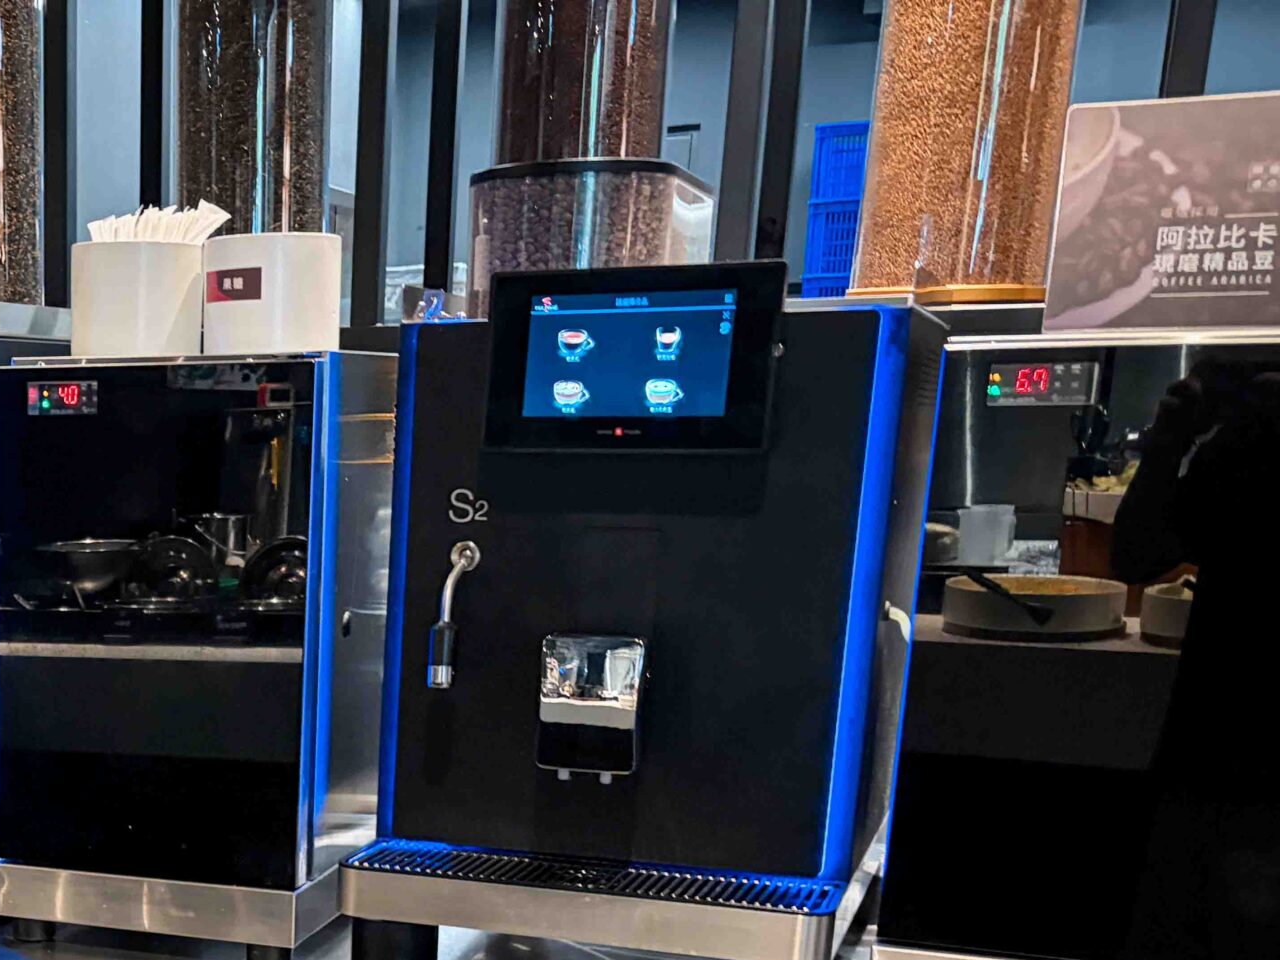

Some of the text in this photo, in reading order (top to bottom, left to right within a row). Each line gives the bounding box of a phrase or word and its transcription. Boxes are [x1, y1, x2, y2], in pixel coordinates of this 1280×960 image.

[1156, 222, 1278, 251] 阿拉比卡
[1152, 250, 1274, 273] 現磨精品豆
[1210, 273, 1271, 286] ARABICA
[448, 488, 489, 523] S2
